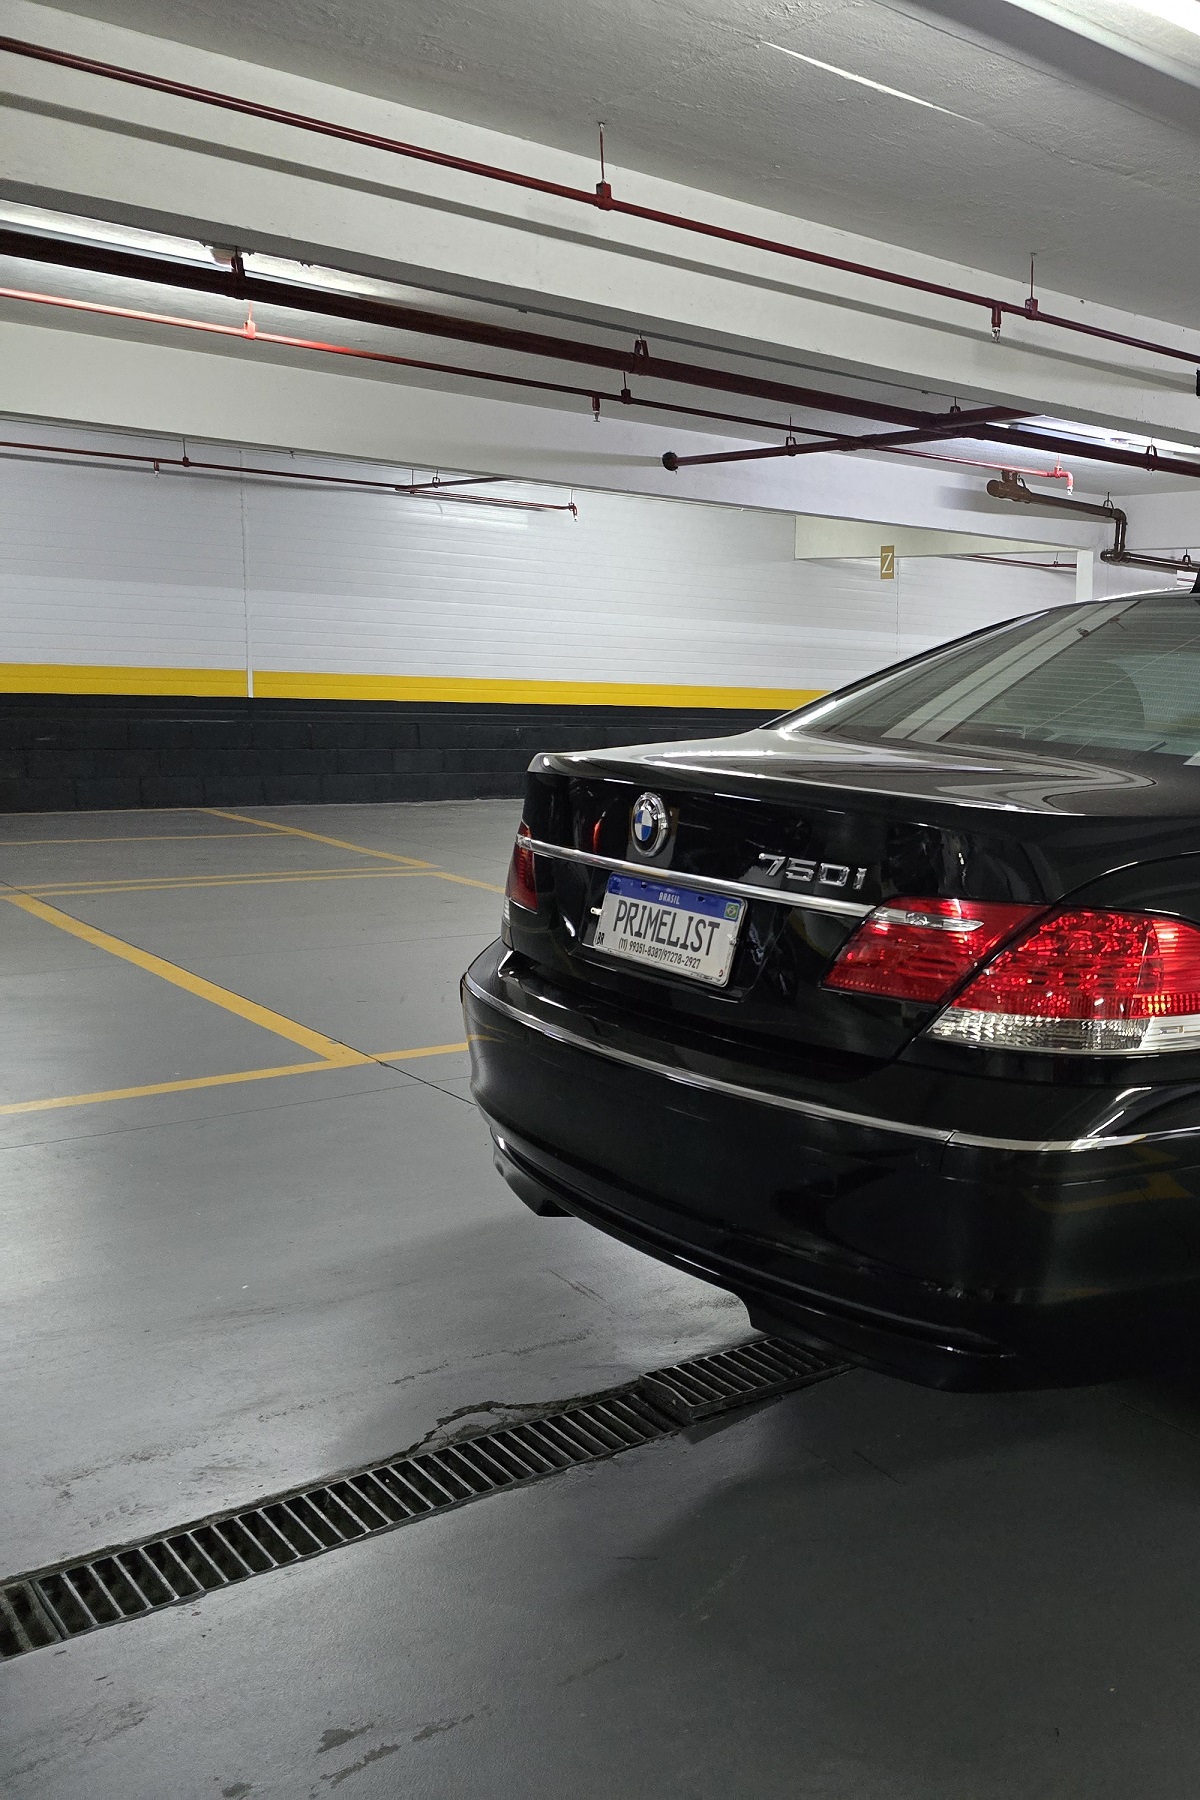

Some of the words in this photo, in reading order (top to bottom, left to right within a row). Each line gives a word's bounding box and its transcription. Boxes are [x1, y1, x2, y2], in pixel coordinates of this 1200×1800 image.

[881, 552, 893, 574] Z
[758, 853, 868, 890] 750i
[658, 892, 680, 905] BRASIL
[613, 899, 721, 957] PRIMELIST
